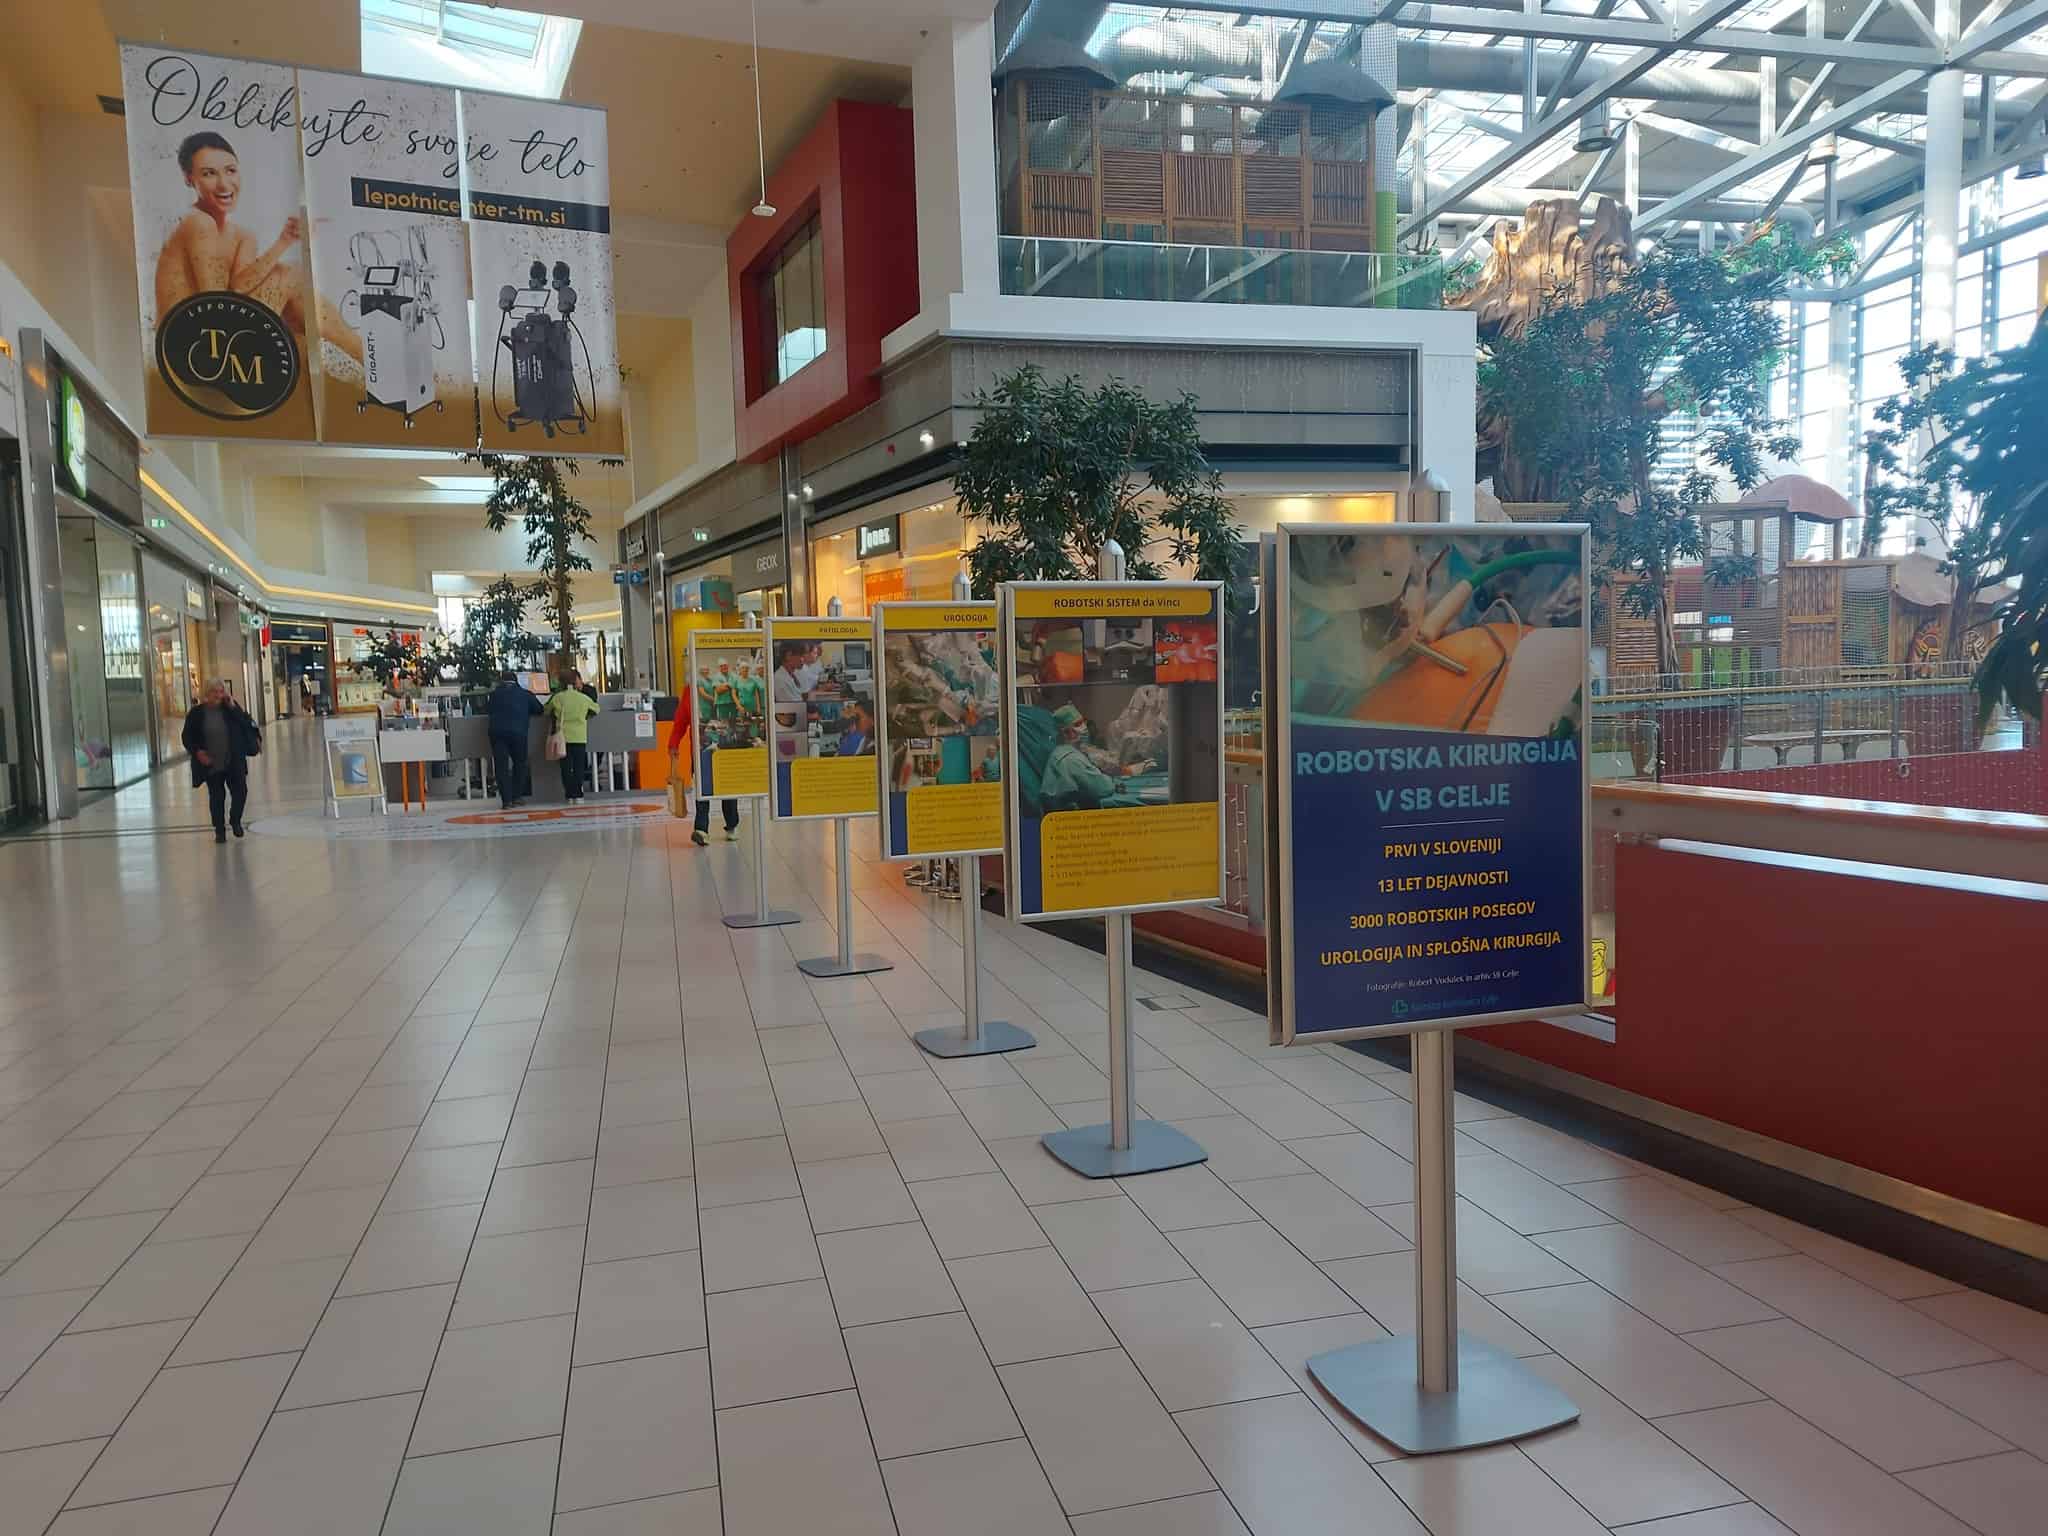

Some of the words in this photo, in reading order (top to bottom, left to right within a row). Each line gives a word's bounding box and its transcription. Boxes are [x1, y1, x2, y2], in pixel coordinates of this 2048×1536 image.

[145, 56, 389, 157] Oblikujte
[406, 130, 498, 178] svoje
[509, 130, 595, 178] telo
[756, 554, 778, 572] GEOX
[1054, 599, 1104, 608] ROBOTSKI
[1106, 598, 1140, 608] SISTEM
[1143, 598, 1154, 607] da
[1296, 747, 1443, 775] ROBOTSKA
[1448, 739, 1578, 768] KIRURGIJA
[1376, 789, 1394, 812] V
[1400, 787, 1432, 811] SB
[1438, 783, 1511, 807] CELJE
[1384, 843, 1417, 858] PRVI
[1421, 843, 1430, 856] V
[1433, 838, 1502, 855] SLOVENIJI
[1378, 879, 1394, 893] 13
[1398, 877, 1422, 892] LET
[1426, 871, 1509, 891] DEJAVNOSTI
[1350, 914, 1383, 929] 3000
[1387, 907, 1468, 927] ROBOTSKIH
[1472, 901, 1536, 919] POSEGOV
[1321, 945, 1403, 966] UROLOGIJA
[1407, 944, 1422, 958] IN
[1427, 936, 1490, 955] SPLOŠNA
[1494, 931, 1561, 950] KIRURGIJA
